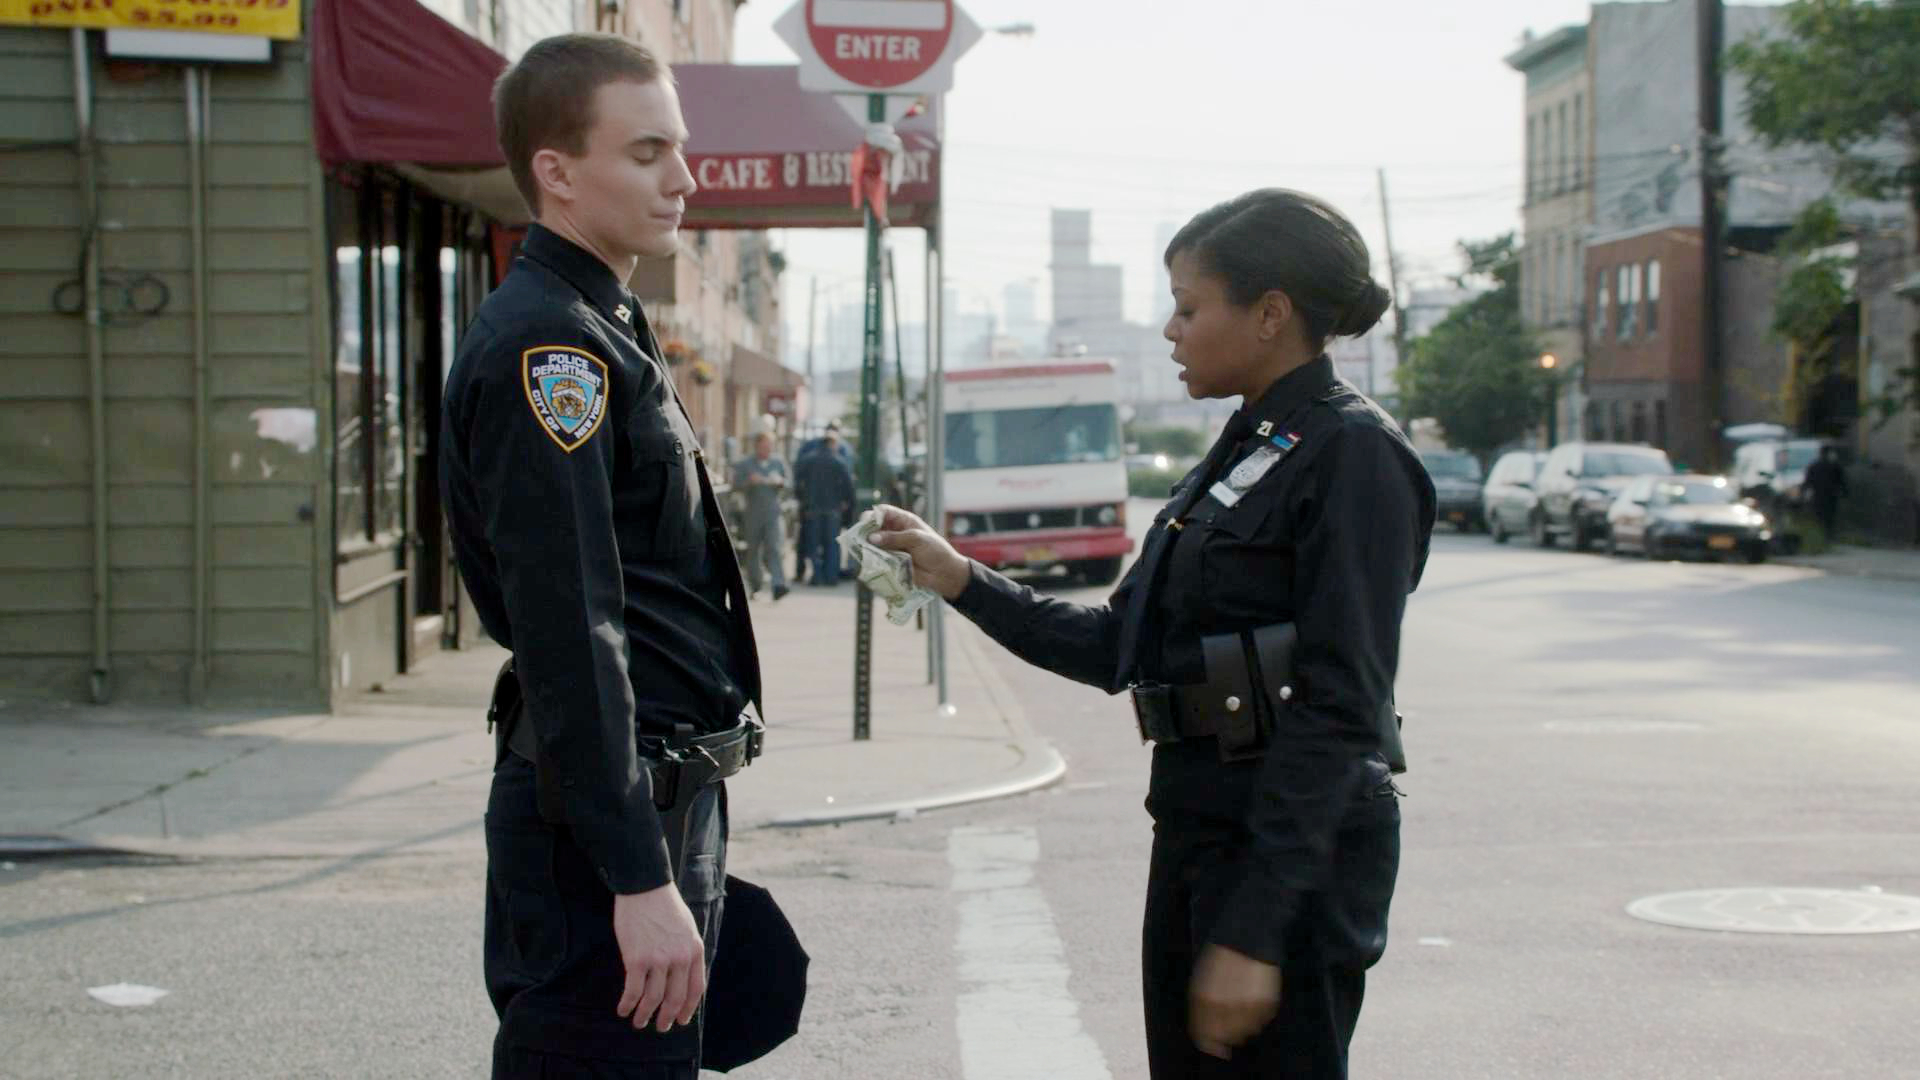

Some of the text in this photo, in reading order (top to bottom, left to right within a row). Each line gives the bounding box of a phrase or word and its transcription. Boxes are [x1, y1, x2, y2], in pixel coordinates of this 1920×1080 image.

[836, 34, 921, 61] ENTER
[699, 158, 773, 190] CAFE
[548, 353, 589, 370] POLICE
[532, 364, 602, 387] DEPARTMENT
[532, 389, 604, 439] CITY OF NEW YORK
